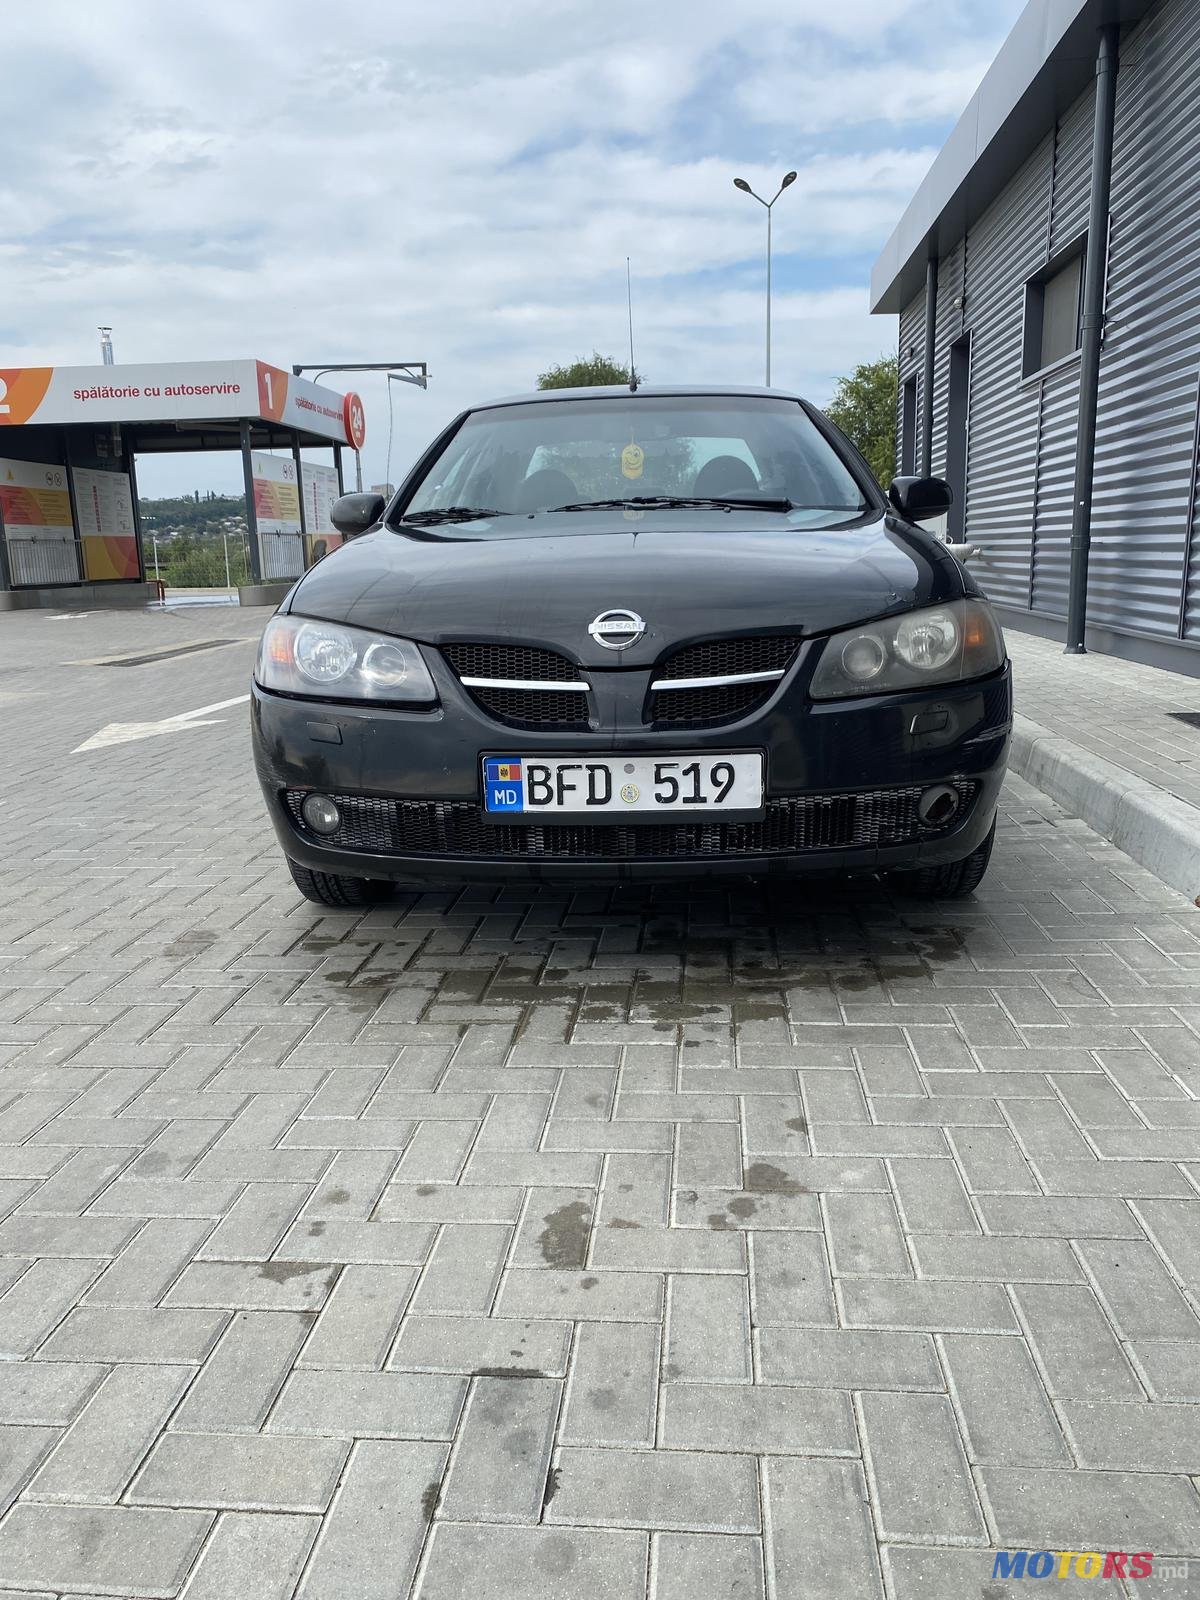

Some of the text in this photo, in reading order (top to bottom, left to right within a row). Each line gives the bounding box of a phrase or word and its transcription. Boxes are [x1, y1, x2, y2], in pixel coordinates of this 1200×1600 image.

[74, 382, 241, 401] spălătorie cu autoservire
[264, 373, 273, 409] 1
[352, 405, 362, 430] 24
[594, 622, 641, 631] NISSAN
[527, 764, 612, 806] BFD
[654, 762, 736, 804] 519
[495, 789, 517, 805] MD
